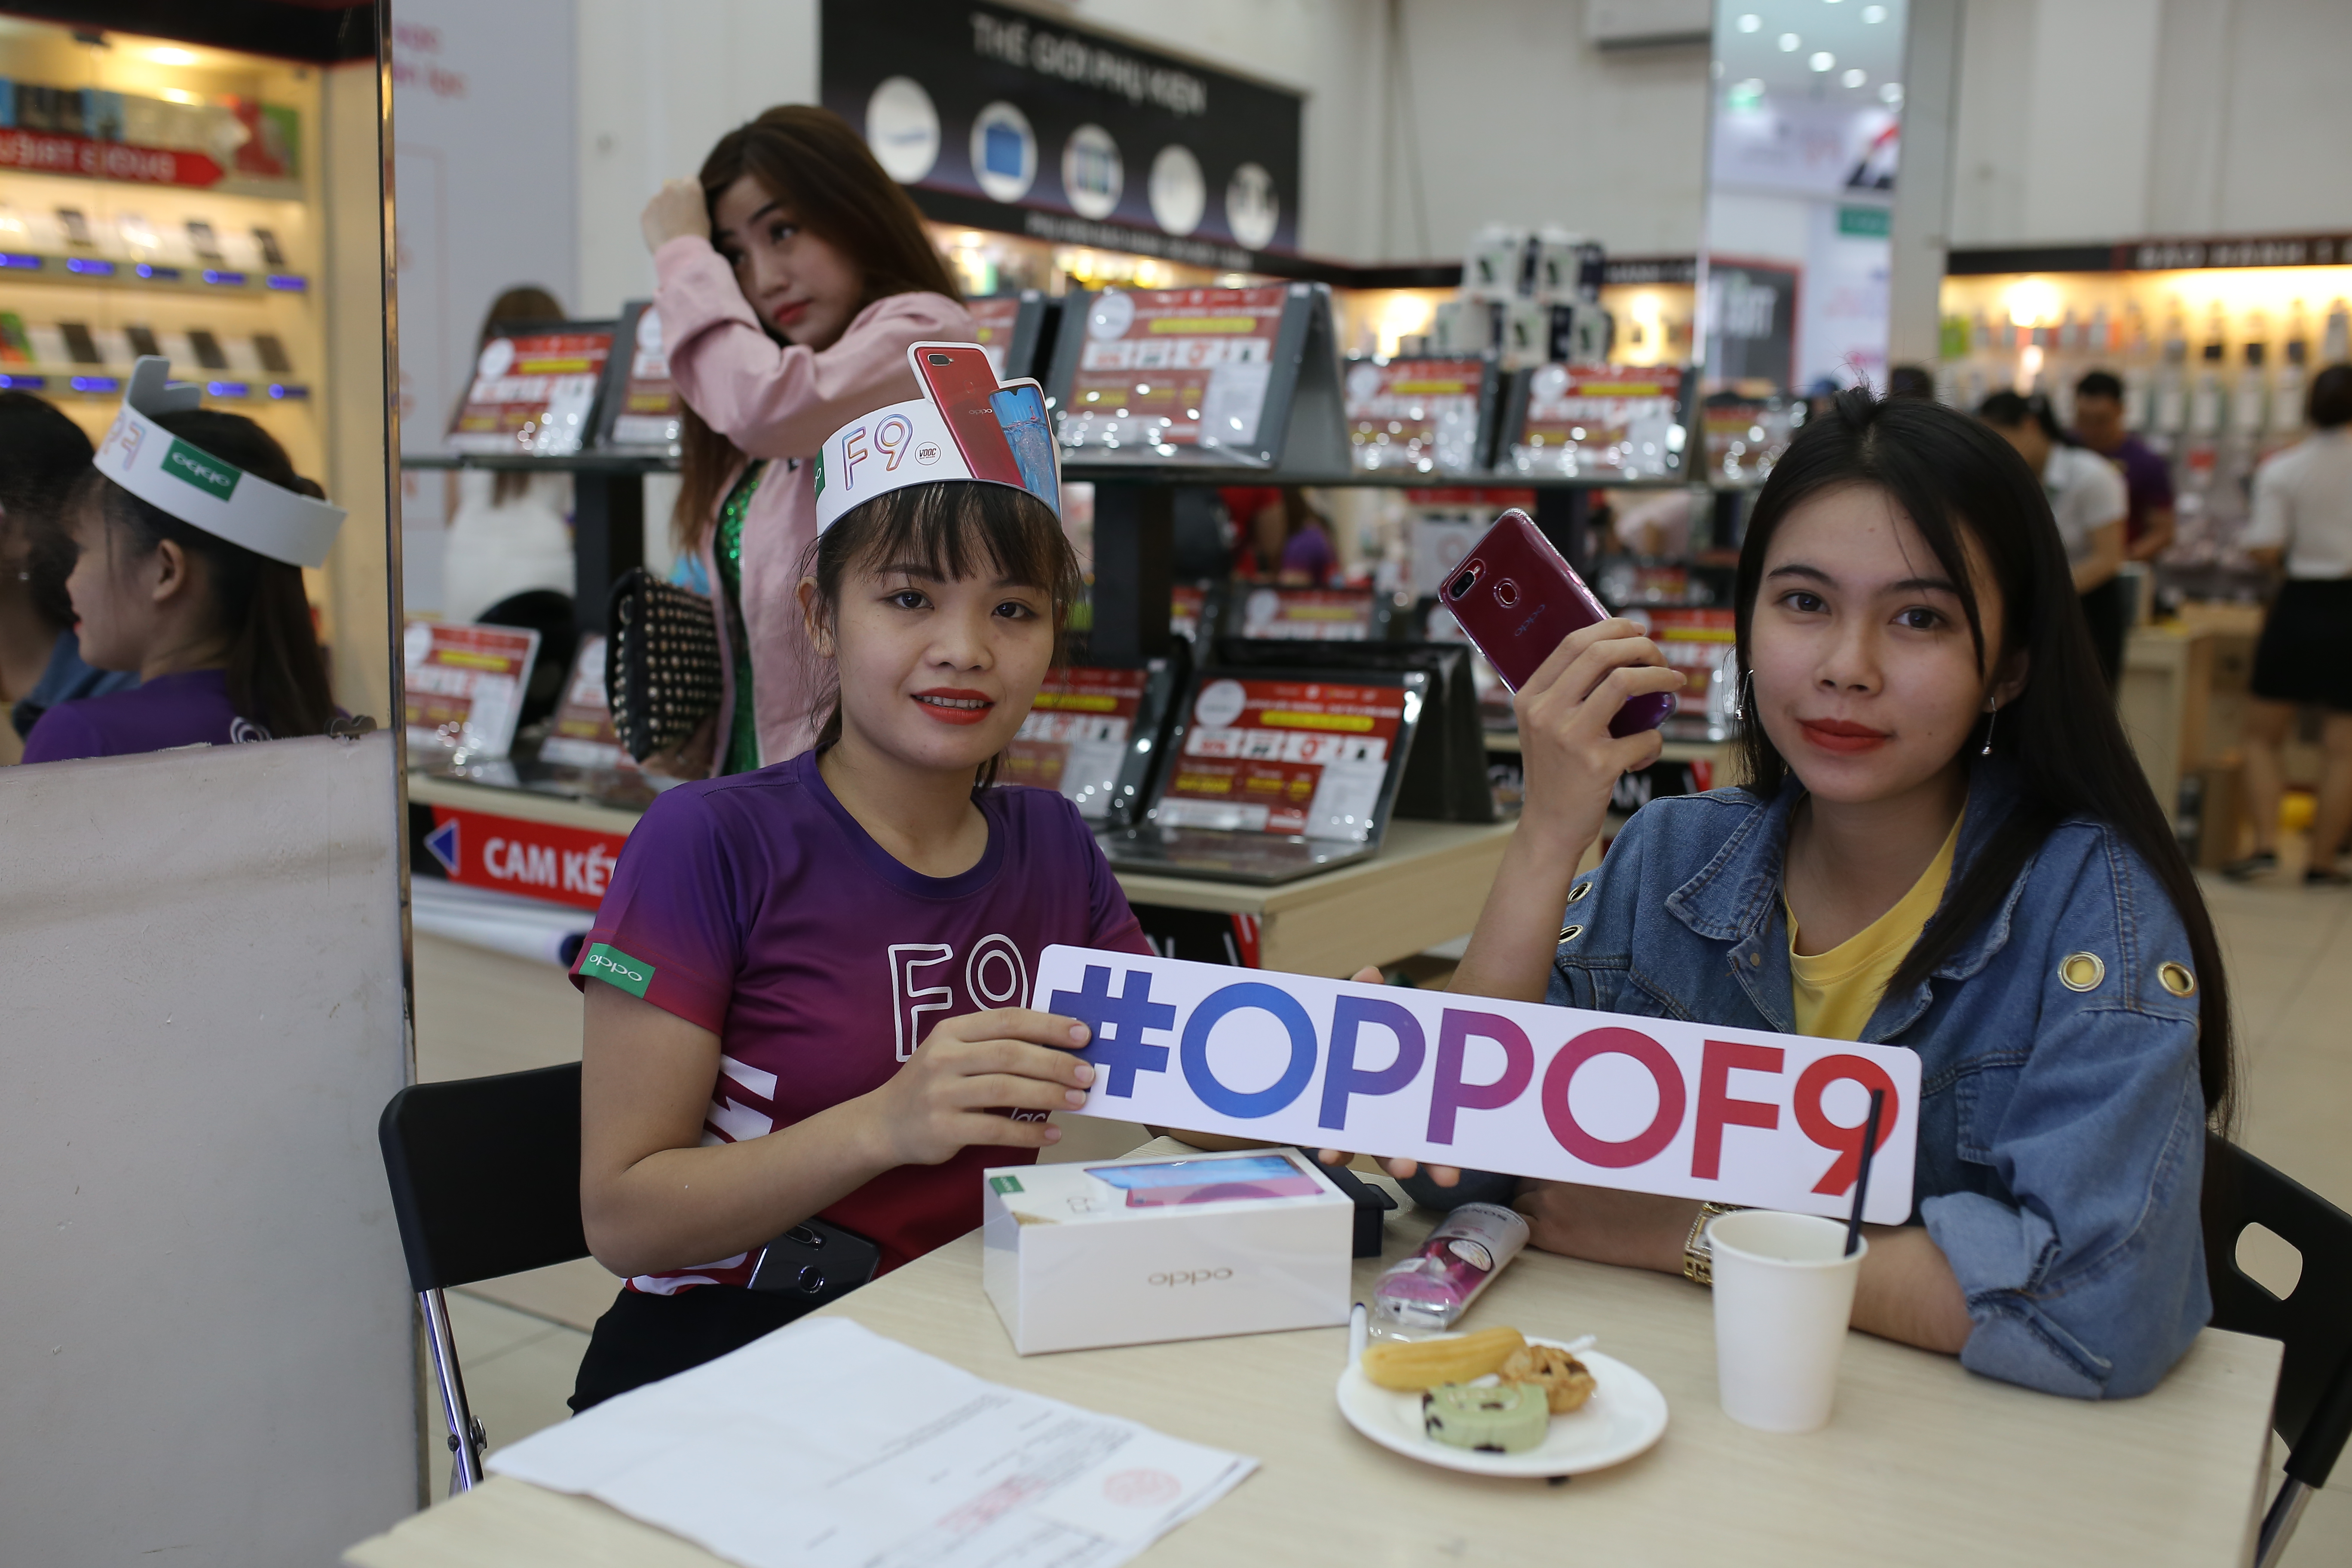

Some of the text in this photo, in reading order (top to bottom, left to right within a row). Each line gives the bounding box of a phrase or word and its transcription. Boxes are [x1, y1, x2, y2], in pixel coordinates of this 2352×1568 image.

[841, 413, 913, 492] F9
[919, 448, 937, 457] VOOC
[1515, 604, 1546, 636] oppo
[483, 836, 558, 889] CAM
[589, 954, 643, 981] oppo
[1042, 964, 1898, 1197] #OPPOF9
[1148, 1268, 1233, 1288] oppo
